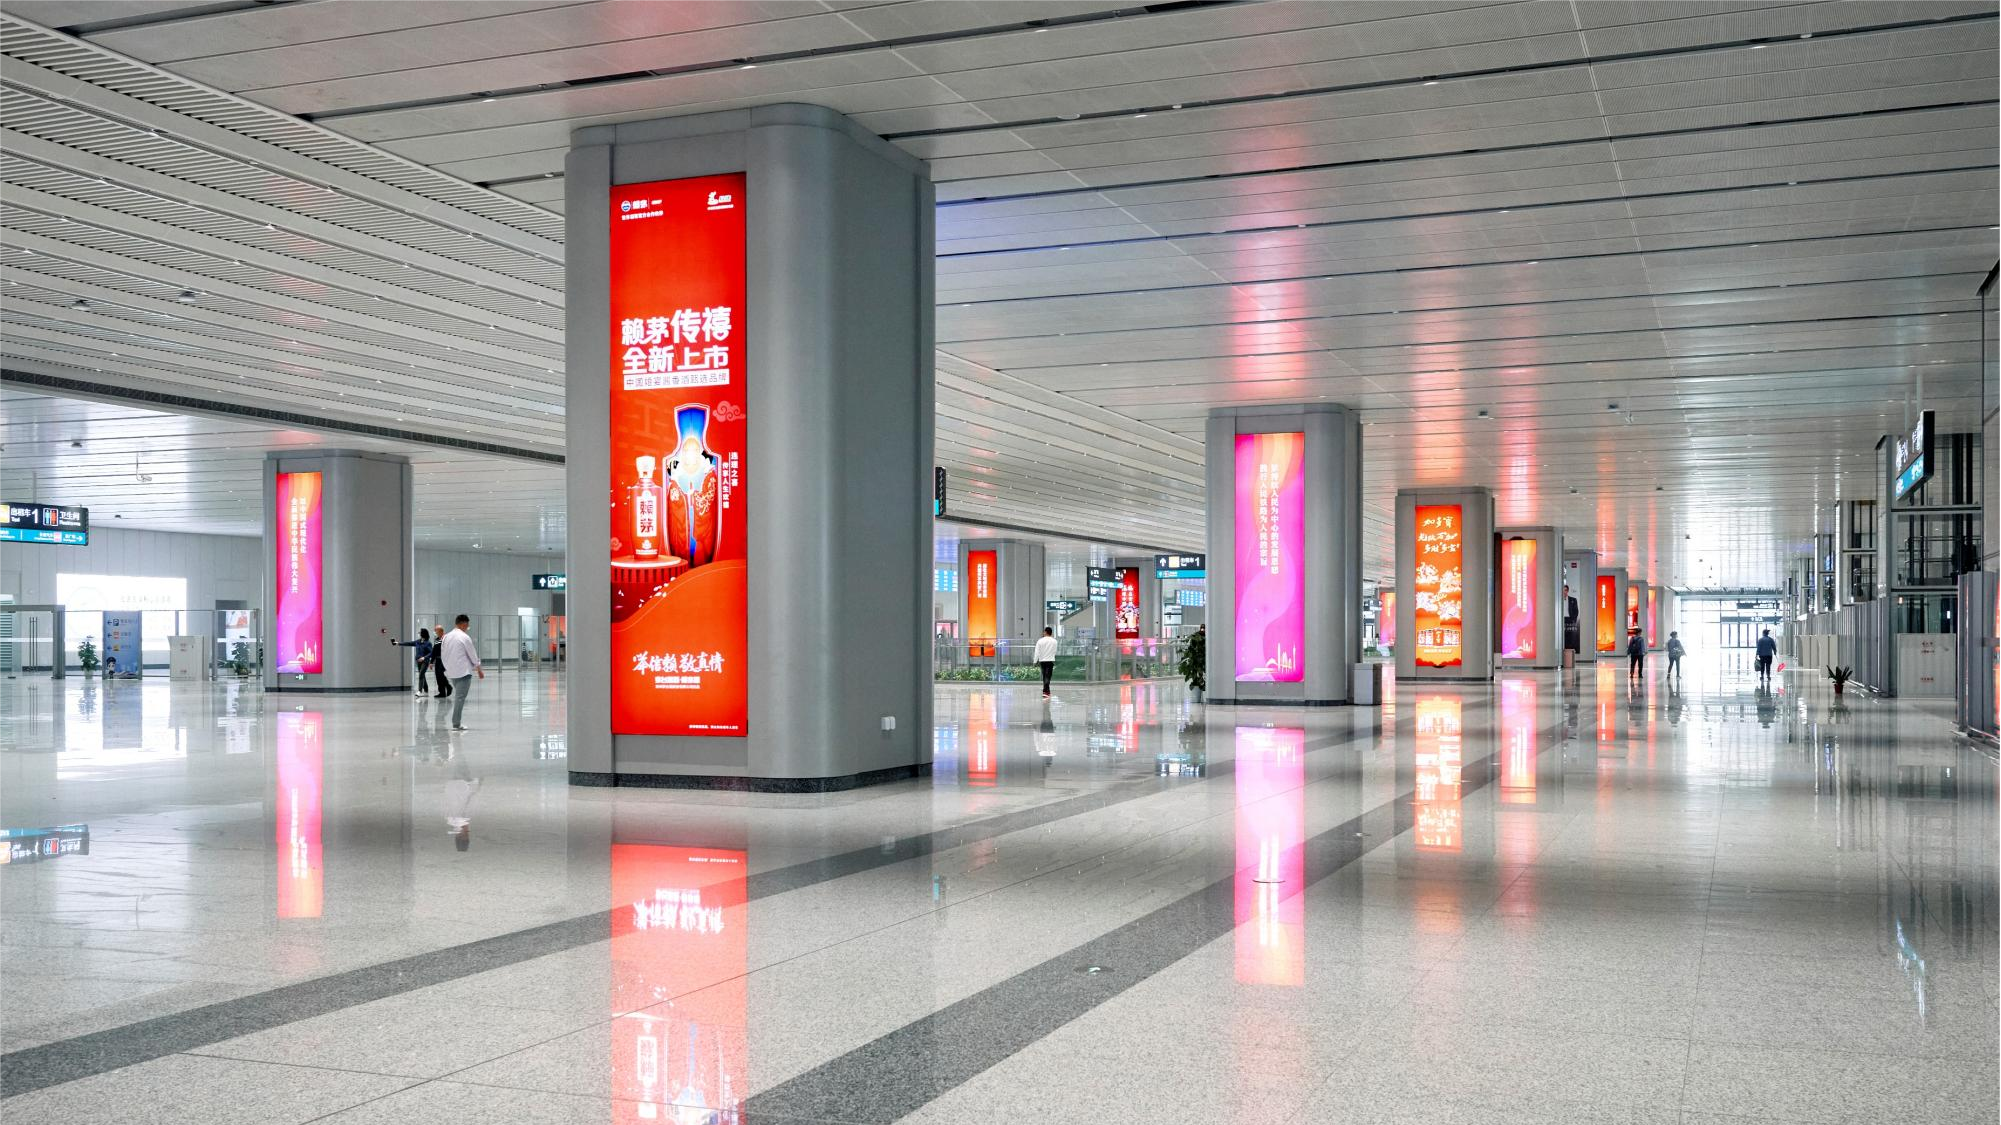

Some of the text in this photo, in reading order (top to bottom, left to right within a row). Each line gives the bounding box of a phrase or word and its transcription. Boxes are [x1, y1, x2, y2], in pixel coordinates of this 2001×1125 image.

[621, 306, 732, 345] 赖茅传禧
[622, 345, 729, 374] 全新上市
[32, 508, 39, 524] 1
[1195, 556, 1200, 567] 1
